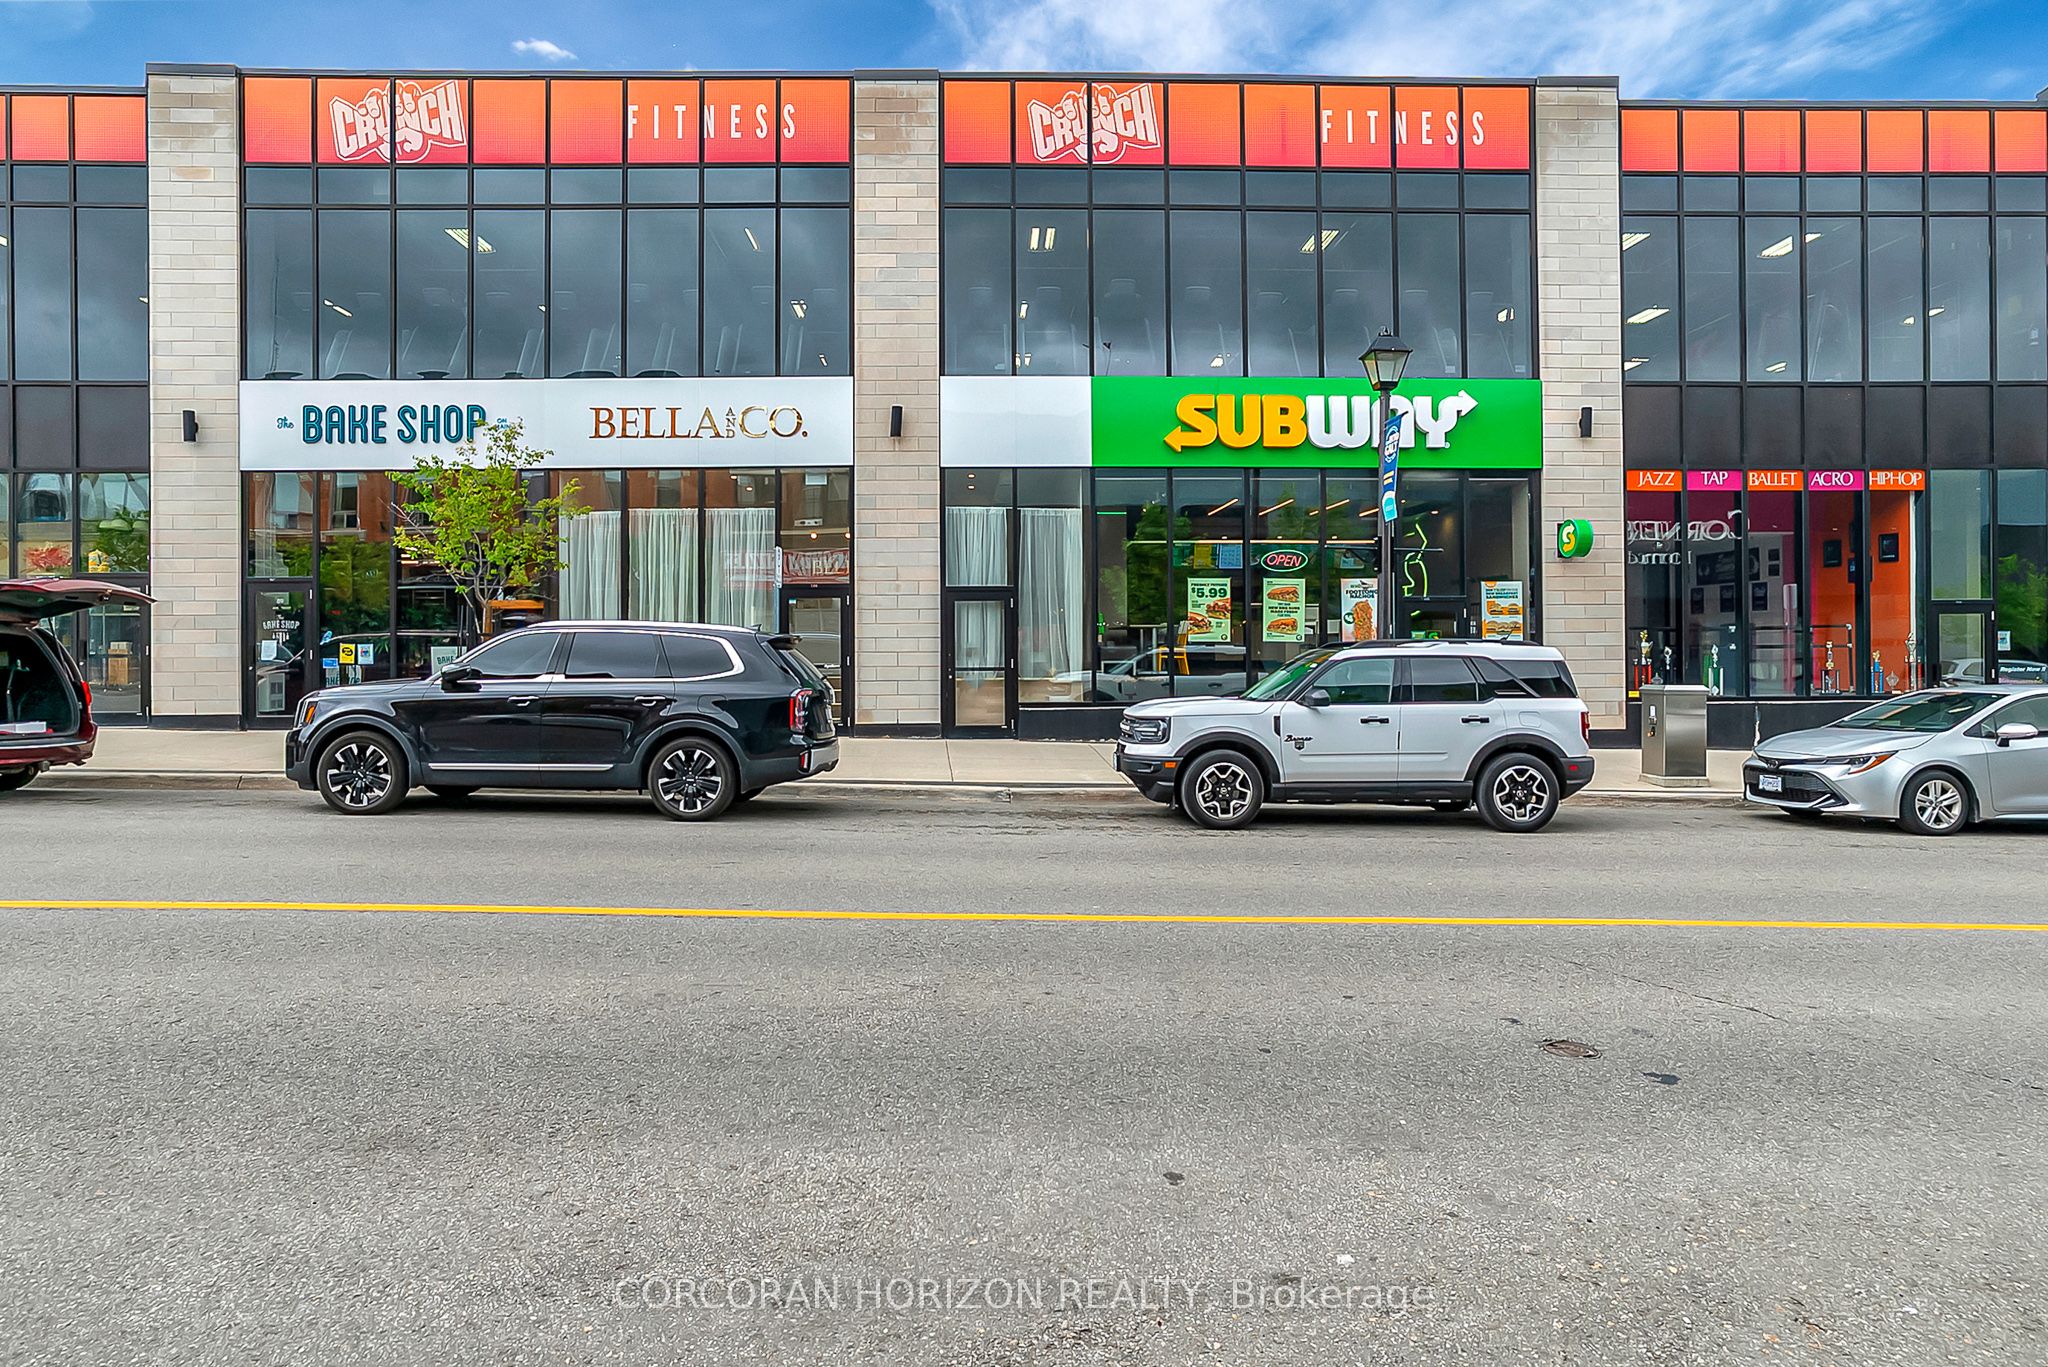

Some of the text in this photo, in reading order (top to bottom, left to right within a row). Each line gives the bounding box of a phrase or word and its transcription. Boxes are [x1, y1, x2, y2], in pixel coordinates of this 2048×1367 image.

[332, 82, 464, 157] CRUNCH
[627, 103, 796, 139] FITNESS
[1029, 85, 1158, 158] CRUNCH
[1321, 109, 1485, 145] FITNESS
[276, 405, 487, 444] The BAKE SHOP
[589, 405, 808, 439] BELLA AND CO.
[1164, 390, 1478, 452] SUBWAY
[1637, 471, 1675, 487] JAZZ
[1700, 472, 1728, 486] TAP
[1749, 471, 1797, 486] BALLET
[1811, 471, 1854, 487] ACRO
[1266, 554, 1302, 567] OPEN
[1191, 587, 1228, 598] $5.99
